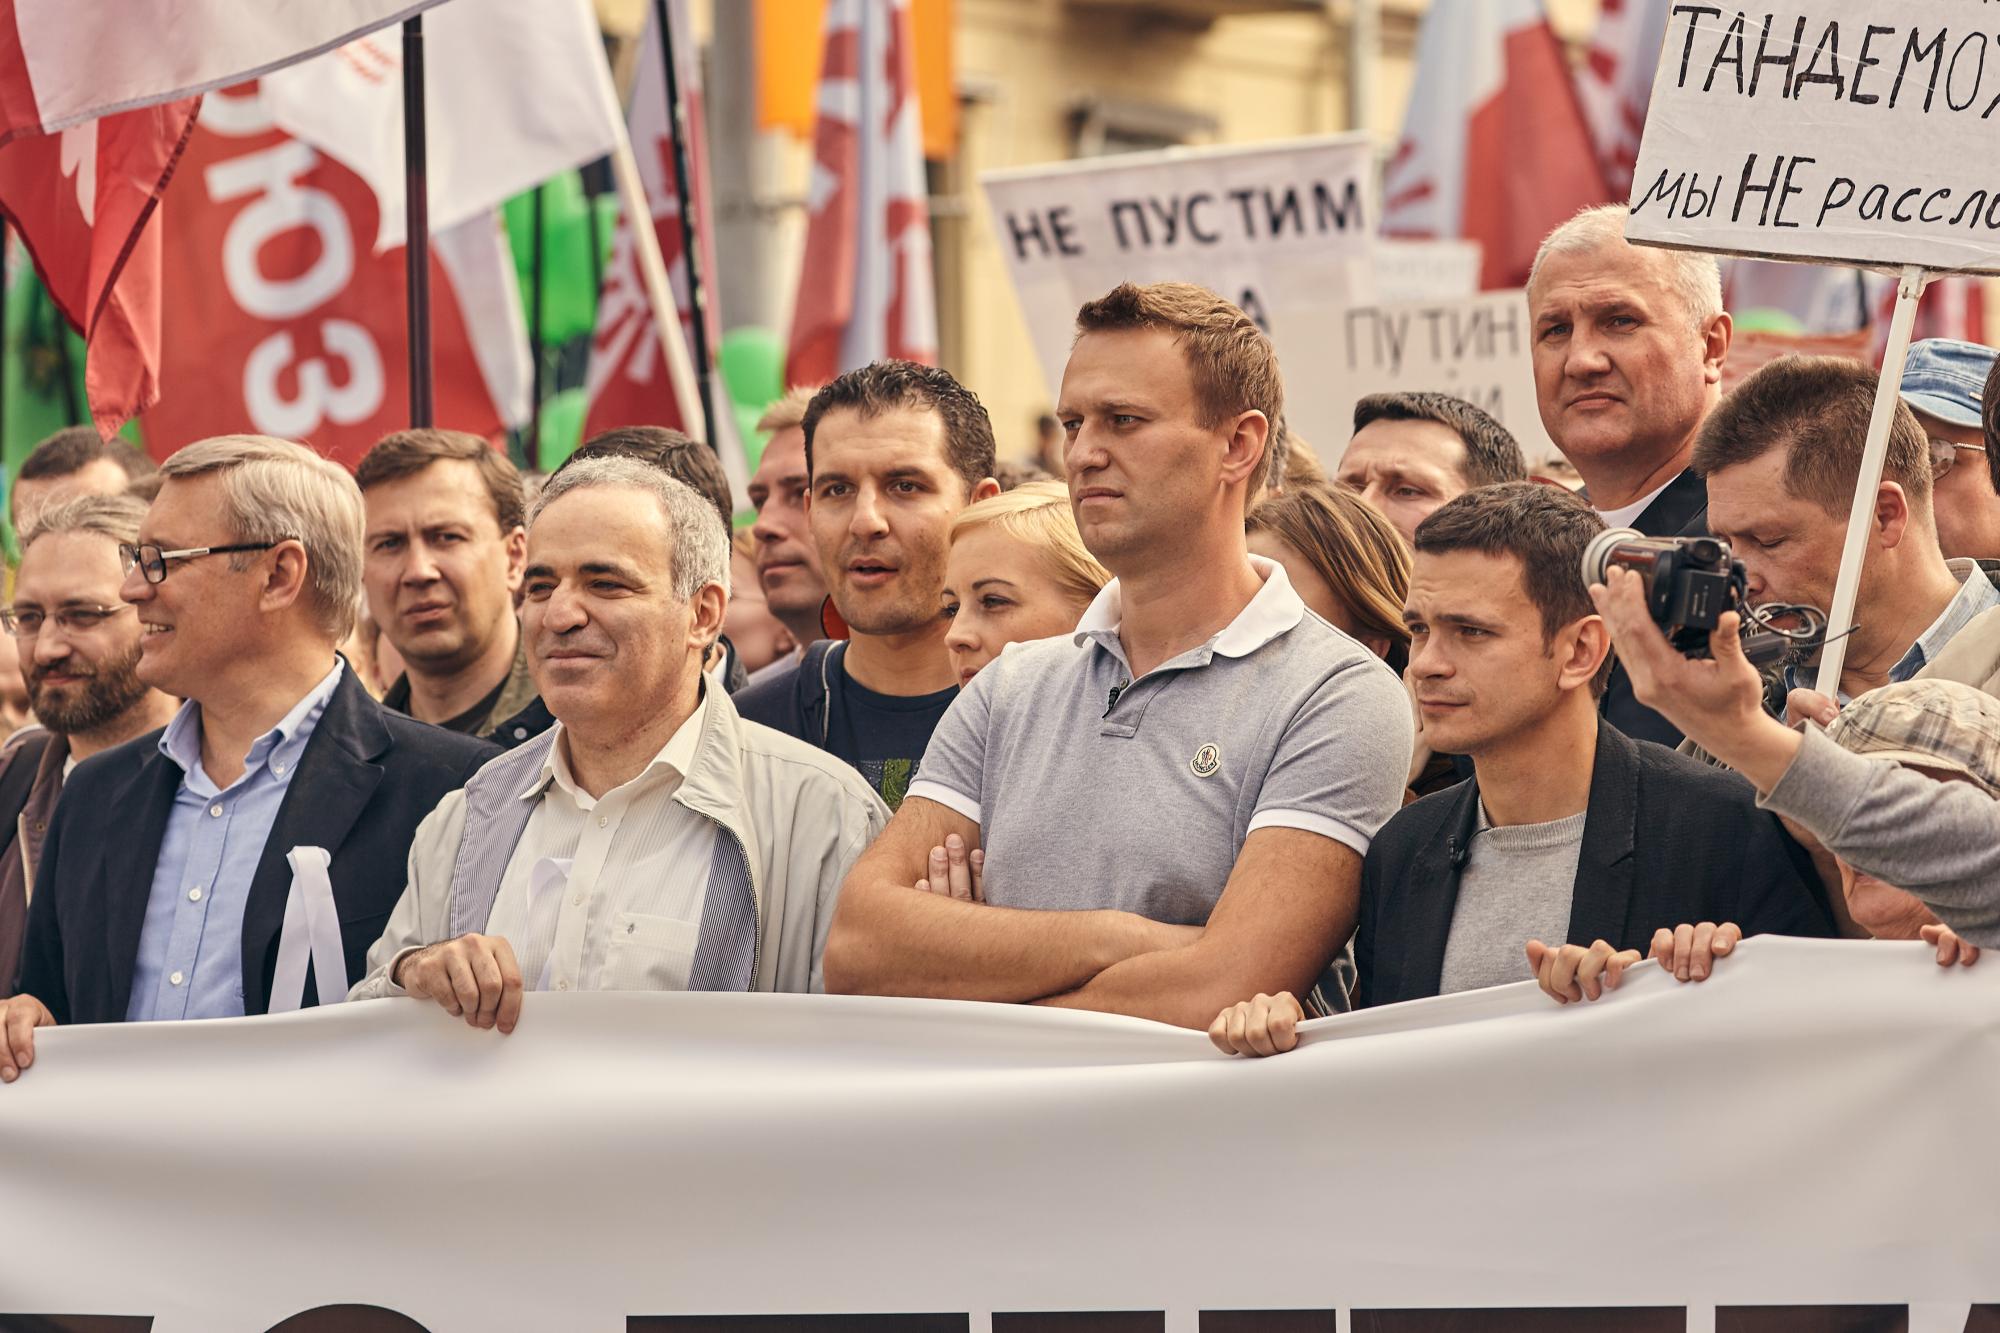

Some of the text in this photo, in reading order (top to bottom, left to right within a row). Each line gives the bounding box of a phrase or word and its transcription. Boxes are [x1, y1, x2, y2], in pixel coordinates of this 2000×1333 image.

[1673, 5, 2000, 118] ТАНДЕМО
[1005, 179, 1364, 260] НЕ ПУСТИМ
[1731, 153, 1815, 227] НЕ
[1343, 304, 1520, 377] ПУТИН
